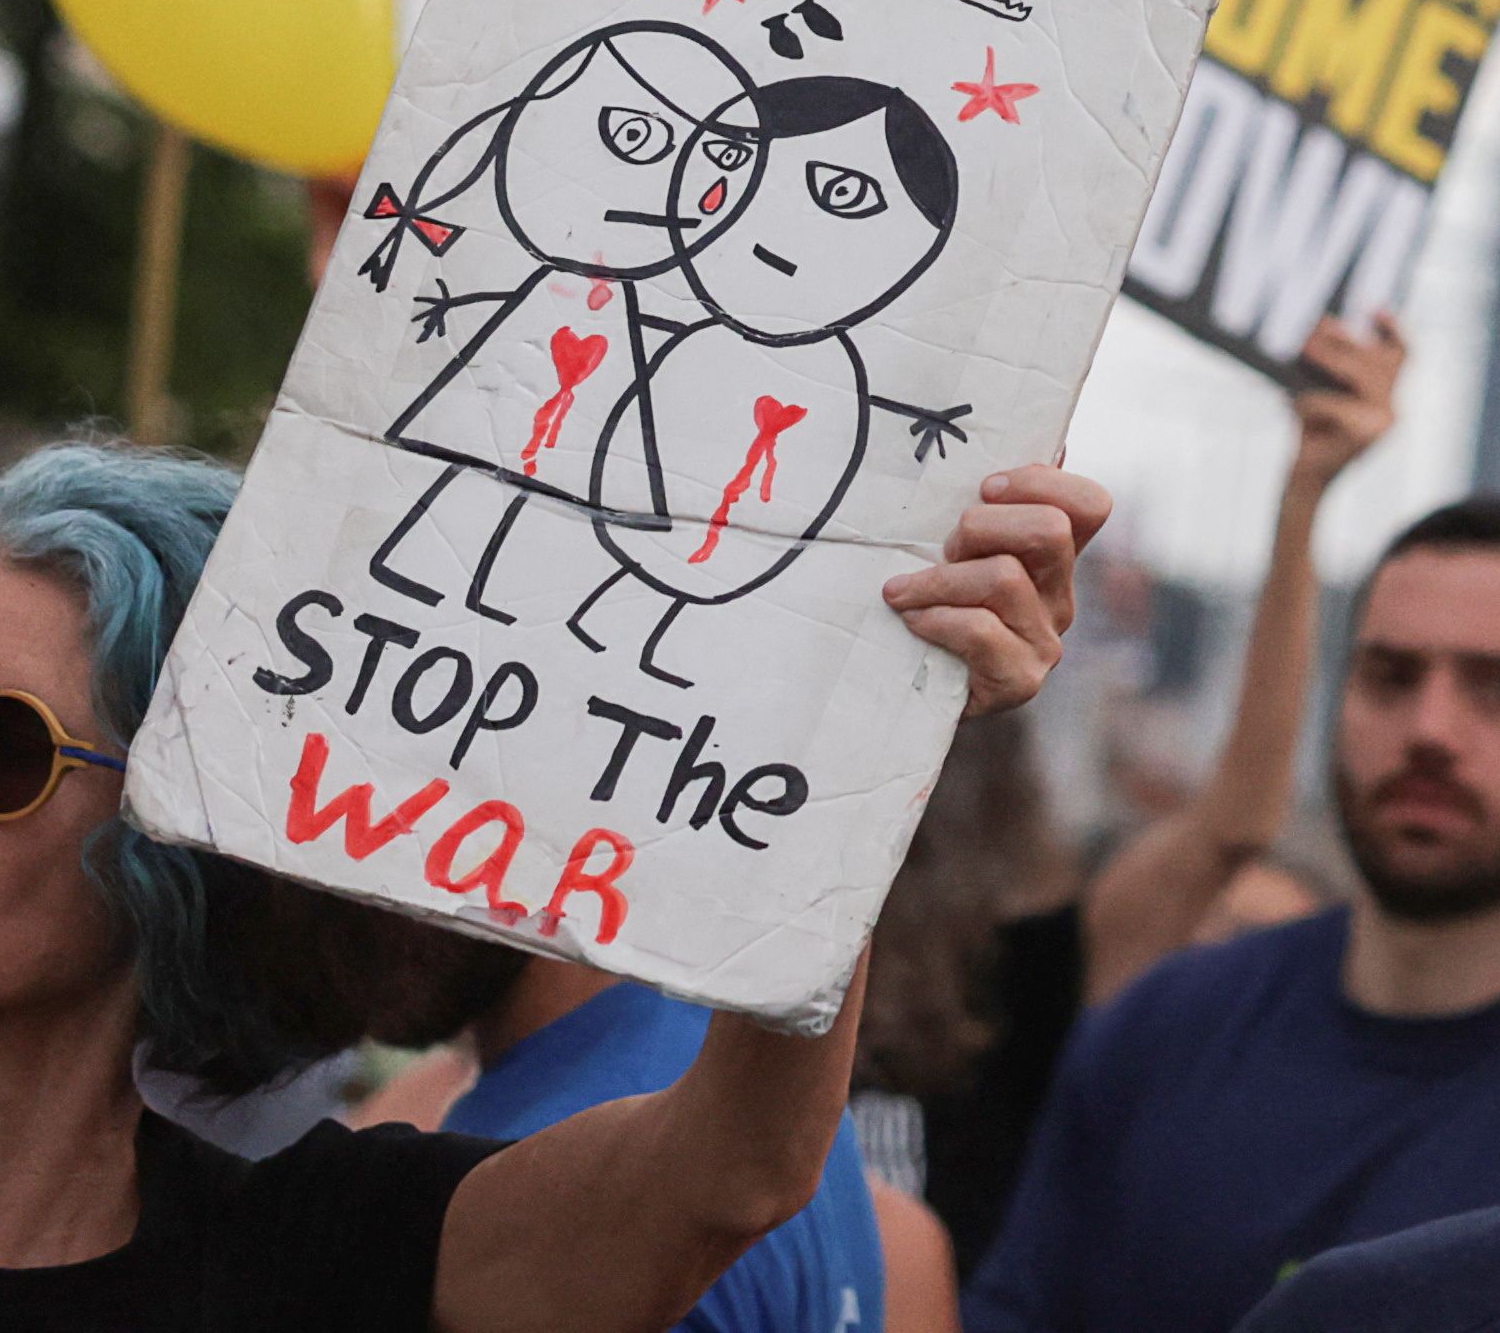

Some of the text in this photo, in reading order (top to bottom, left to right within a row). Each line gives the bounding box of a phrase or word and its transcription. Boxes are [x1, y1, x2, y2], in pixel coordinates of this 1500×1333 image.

[1125, 59, 1432, 365] OW!
[252, 590, 810, 851] STOP The
